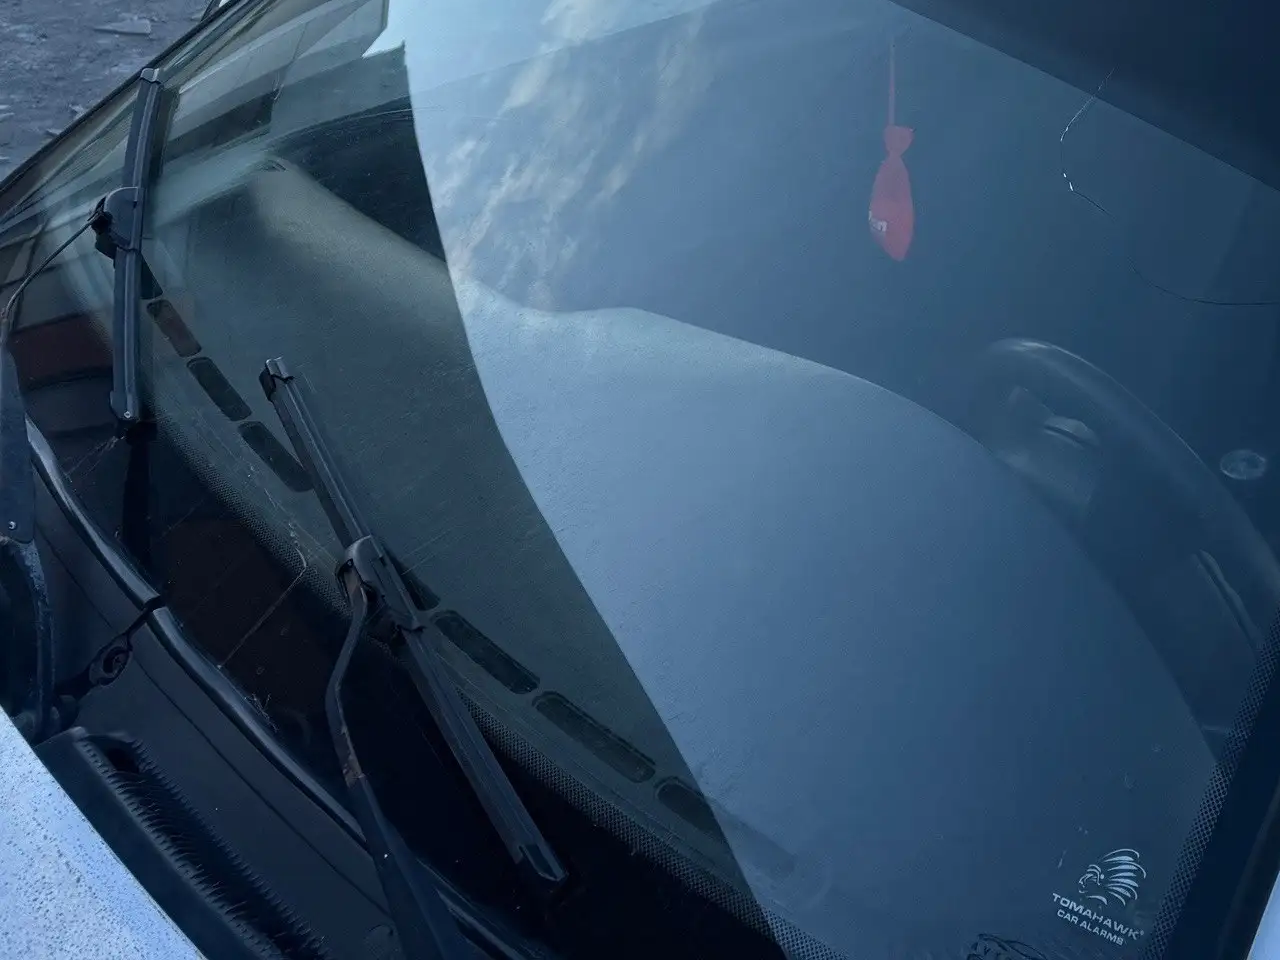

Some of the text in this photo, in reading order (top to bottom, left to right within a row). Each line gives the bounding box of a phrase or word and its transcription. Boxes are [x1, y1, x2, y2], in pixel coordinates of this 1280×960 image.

[1052, 892, 1141, 941] TOMAHAWK
[1056, 909, 1125, 947] CAR ALARMS
